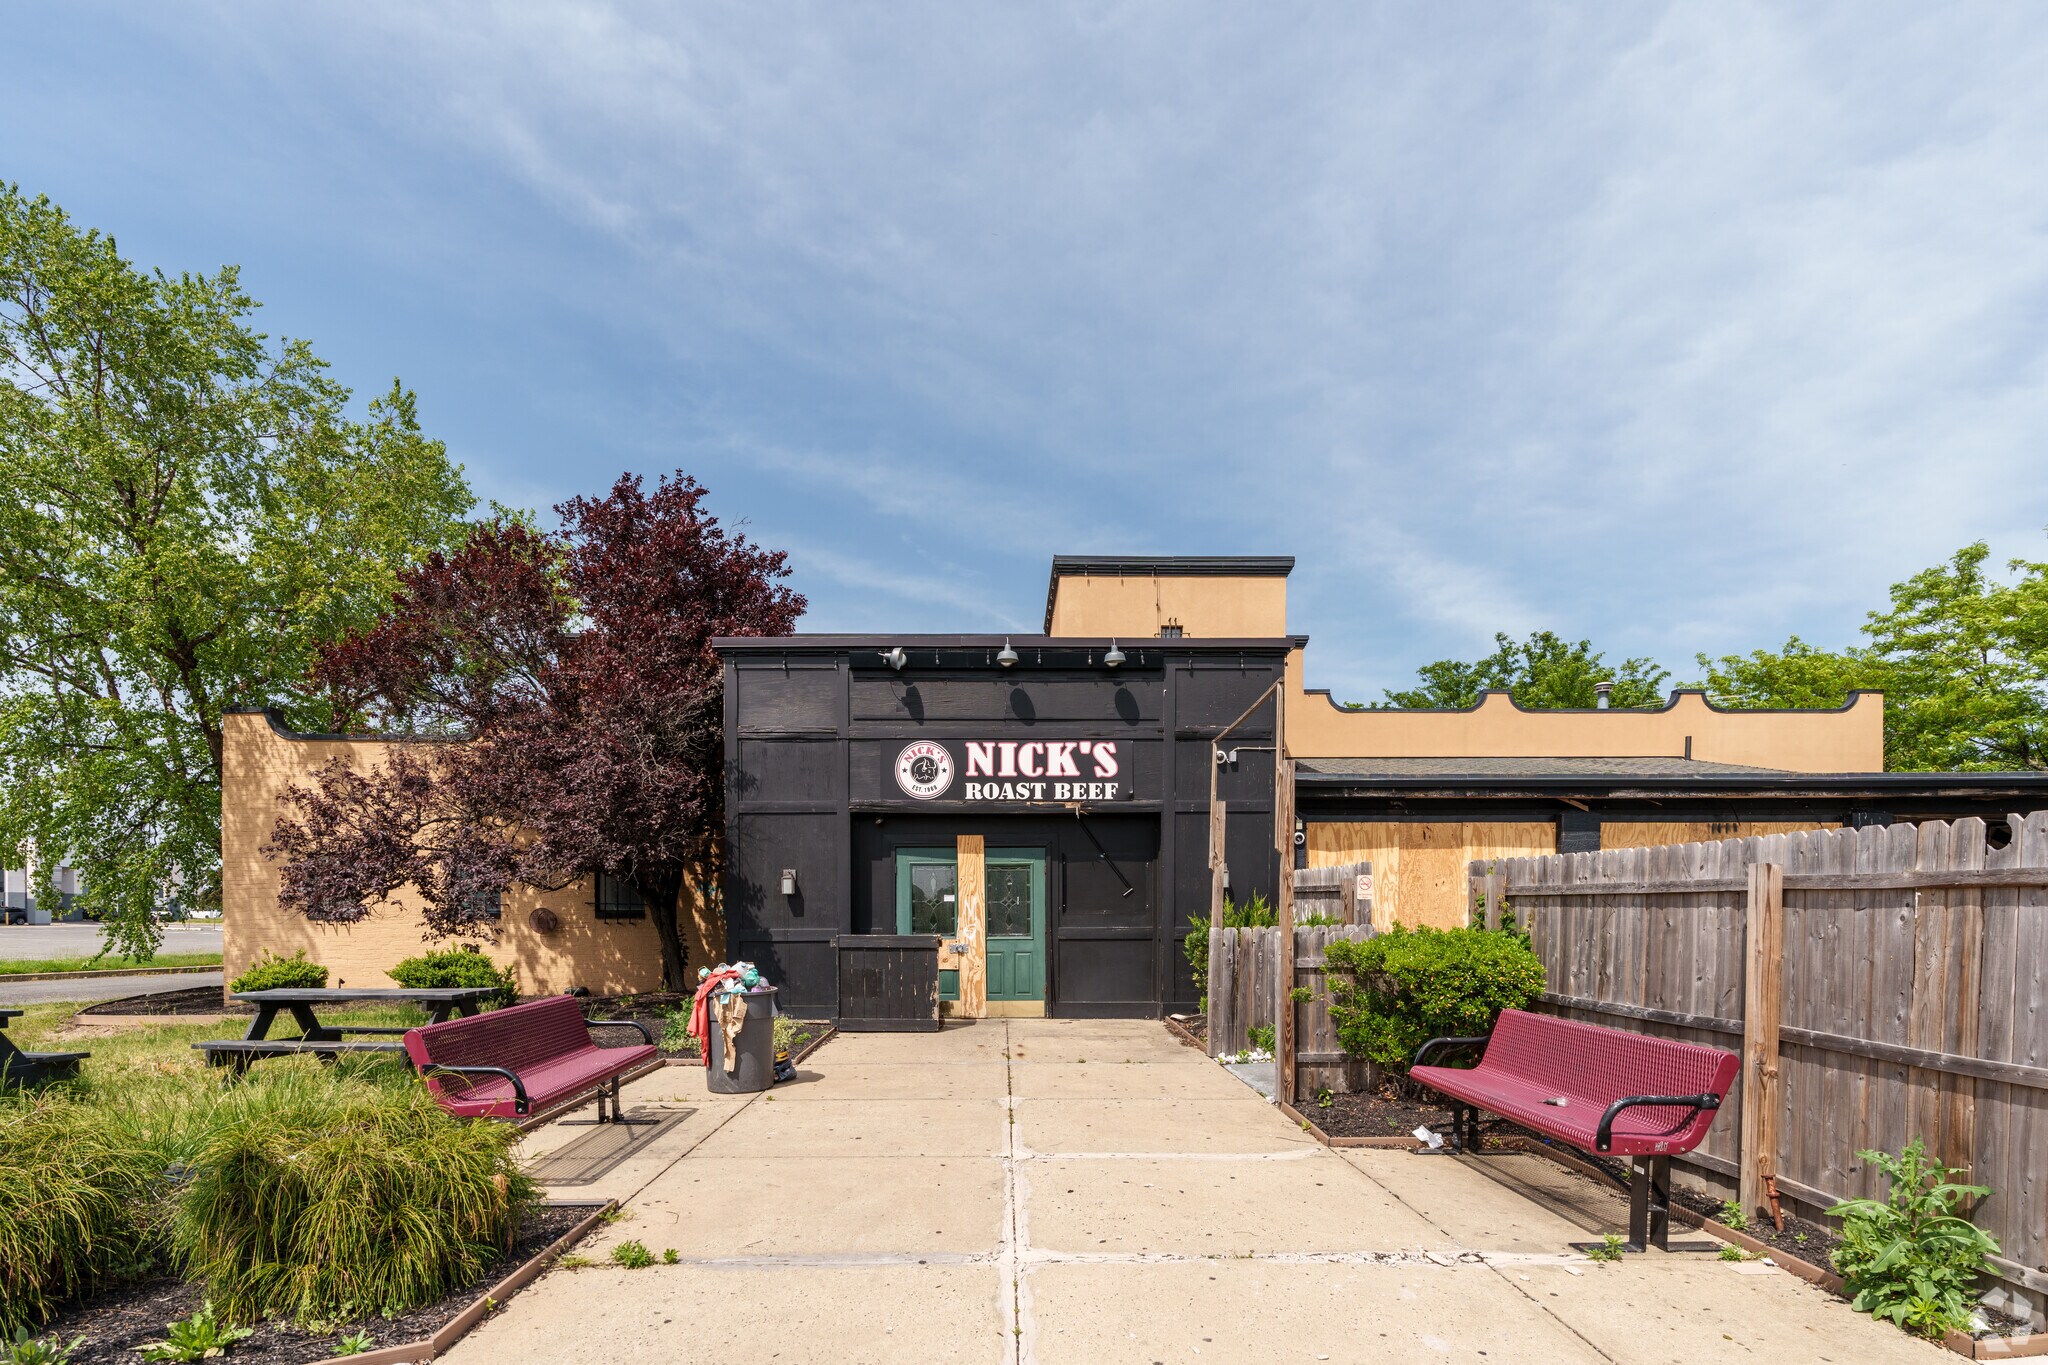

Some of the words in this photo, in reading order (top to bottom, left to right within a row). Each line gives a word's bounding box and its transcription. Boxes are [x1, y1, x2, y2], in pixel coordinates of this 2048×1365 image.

[904, 746, 946, 764] NICK'S
[965, 741, 1119, 778] NICK'S
[965, 782, 1046, 800] ROAST
[1054, 782, 1118, 800] BEEF
